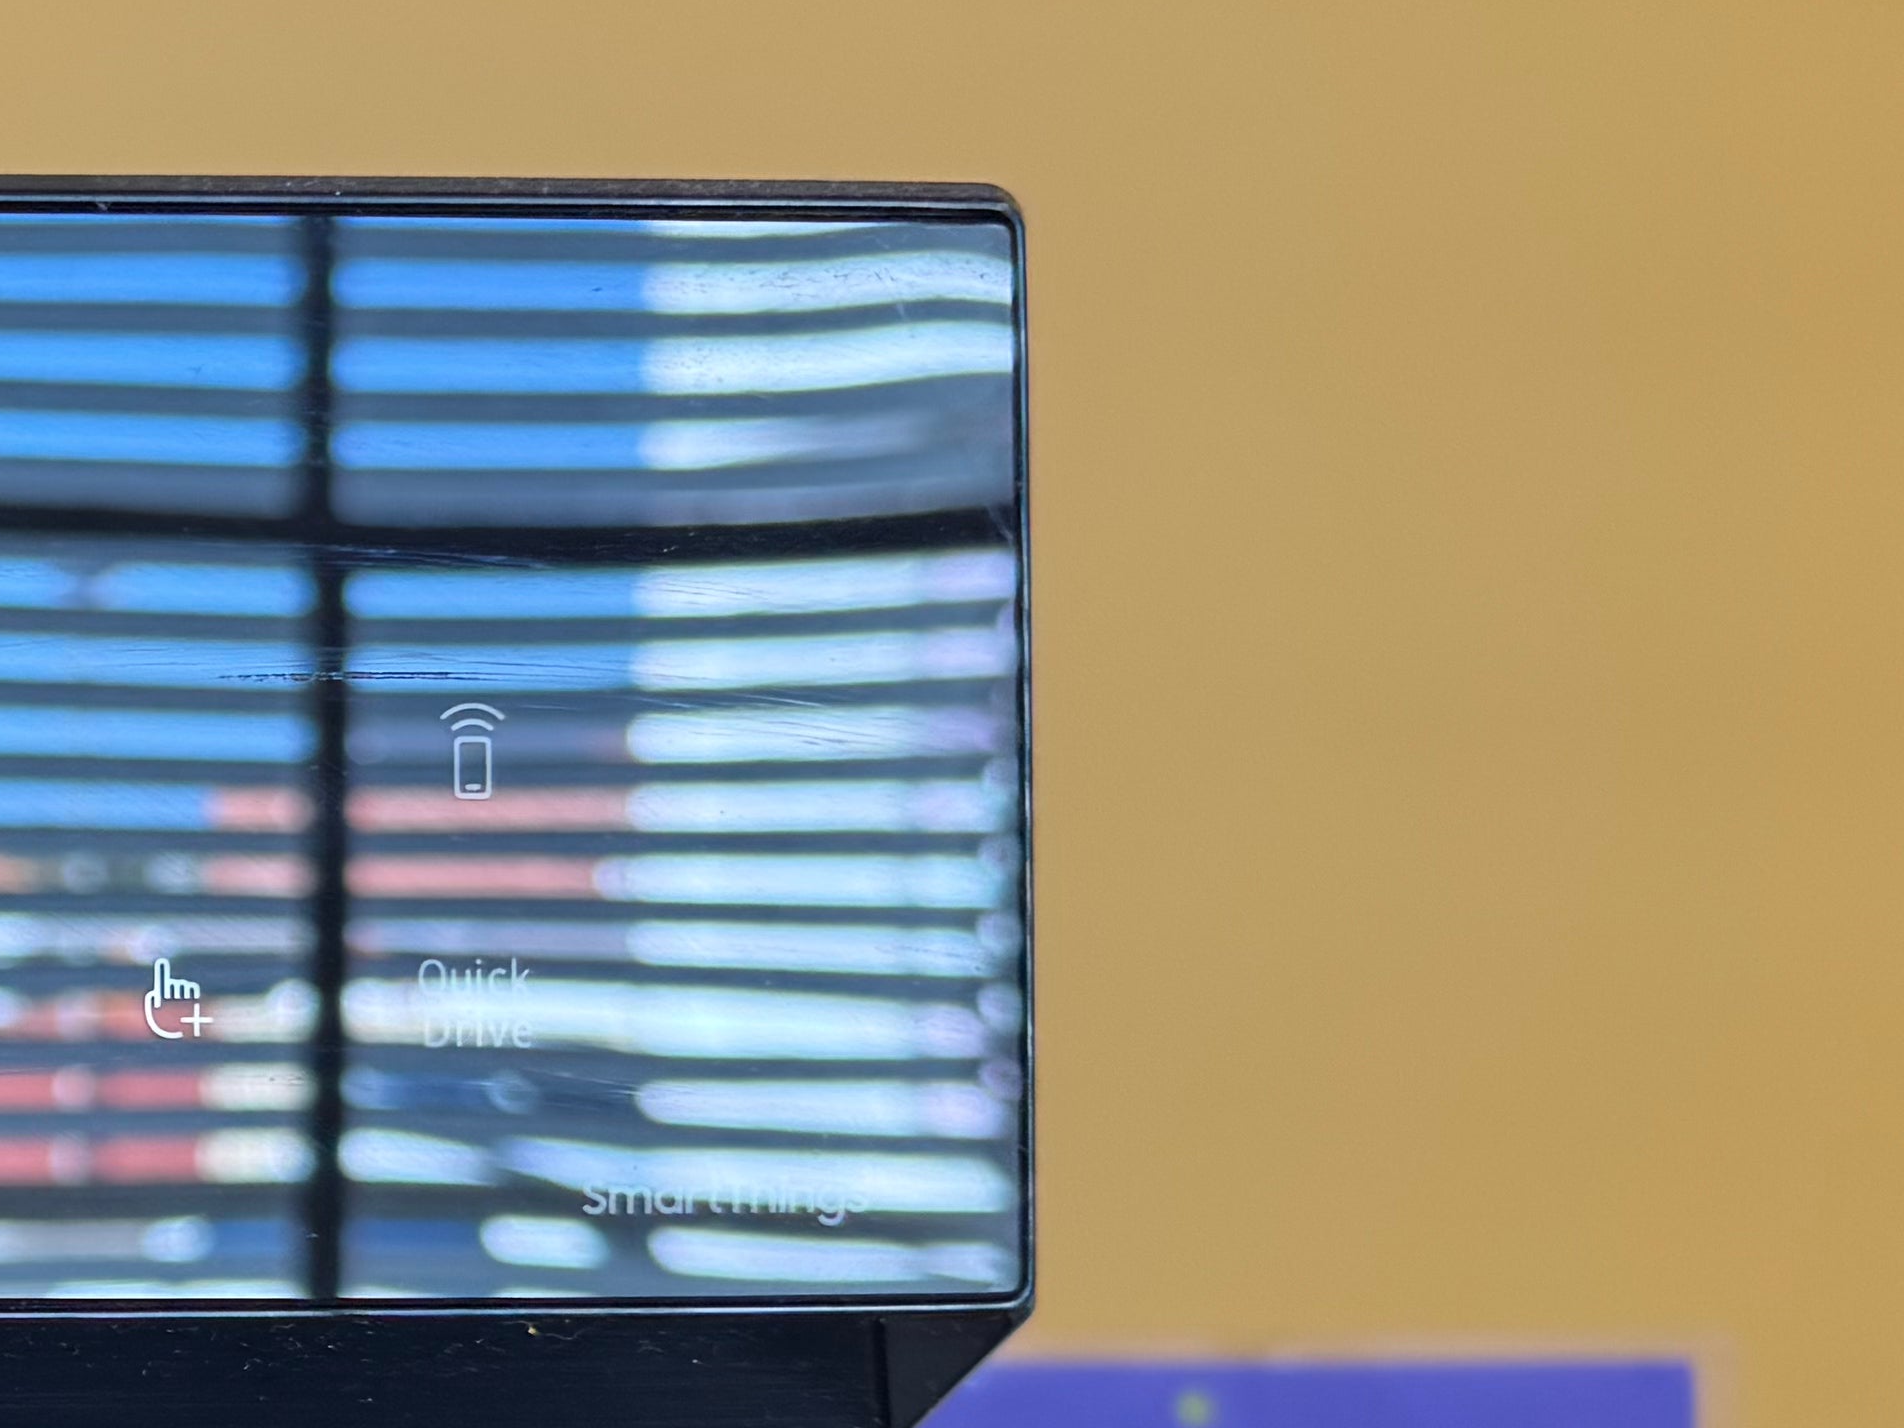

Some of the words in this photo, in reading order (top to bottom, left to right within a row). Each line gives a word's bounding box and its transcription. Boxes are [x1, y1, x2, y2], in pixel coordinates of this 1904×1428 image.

[417, 956, 532, 998] Quick
[421, 1010, 534, 1049] Drive
[580, 1177, 870, 1227] SmartThings
